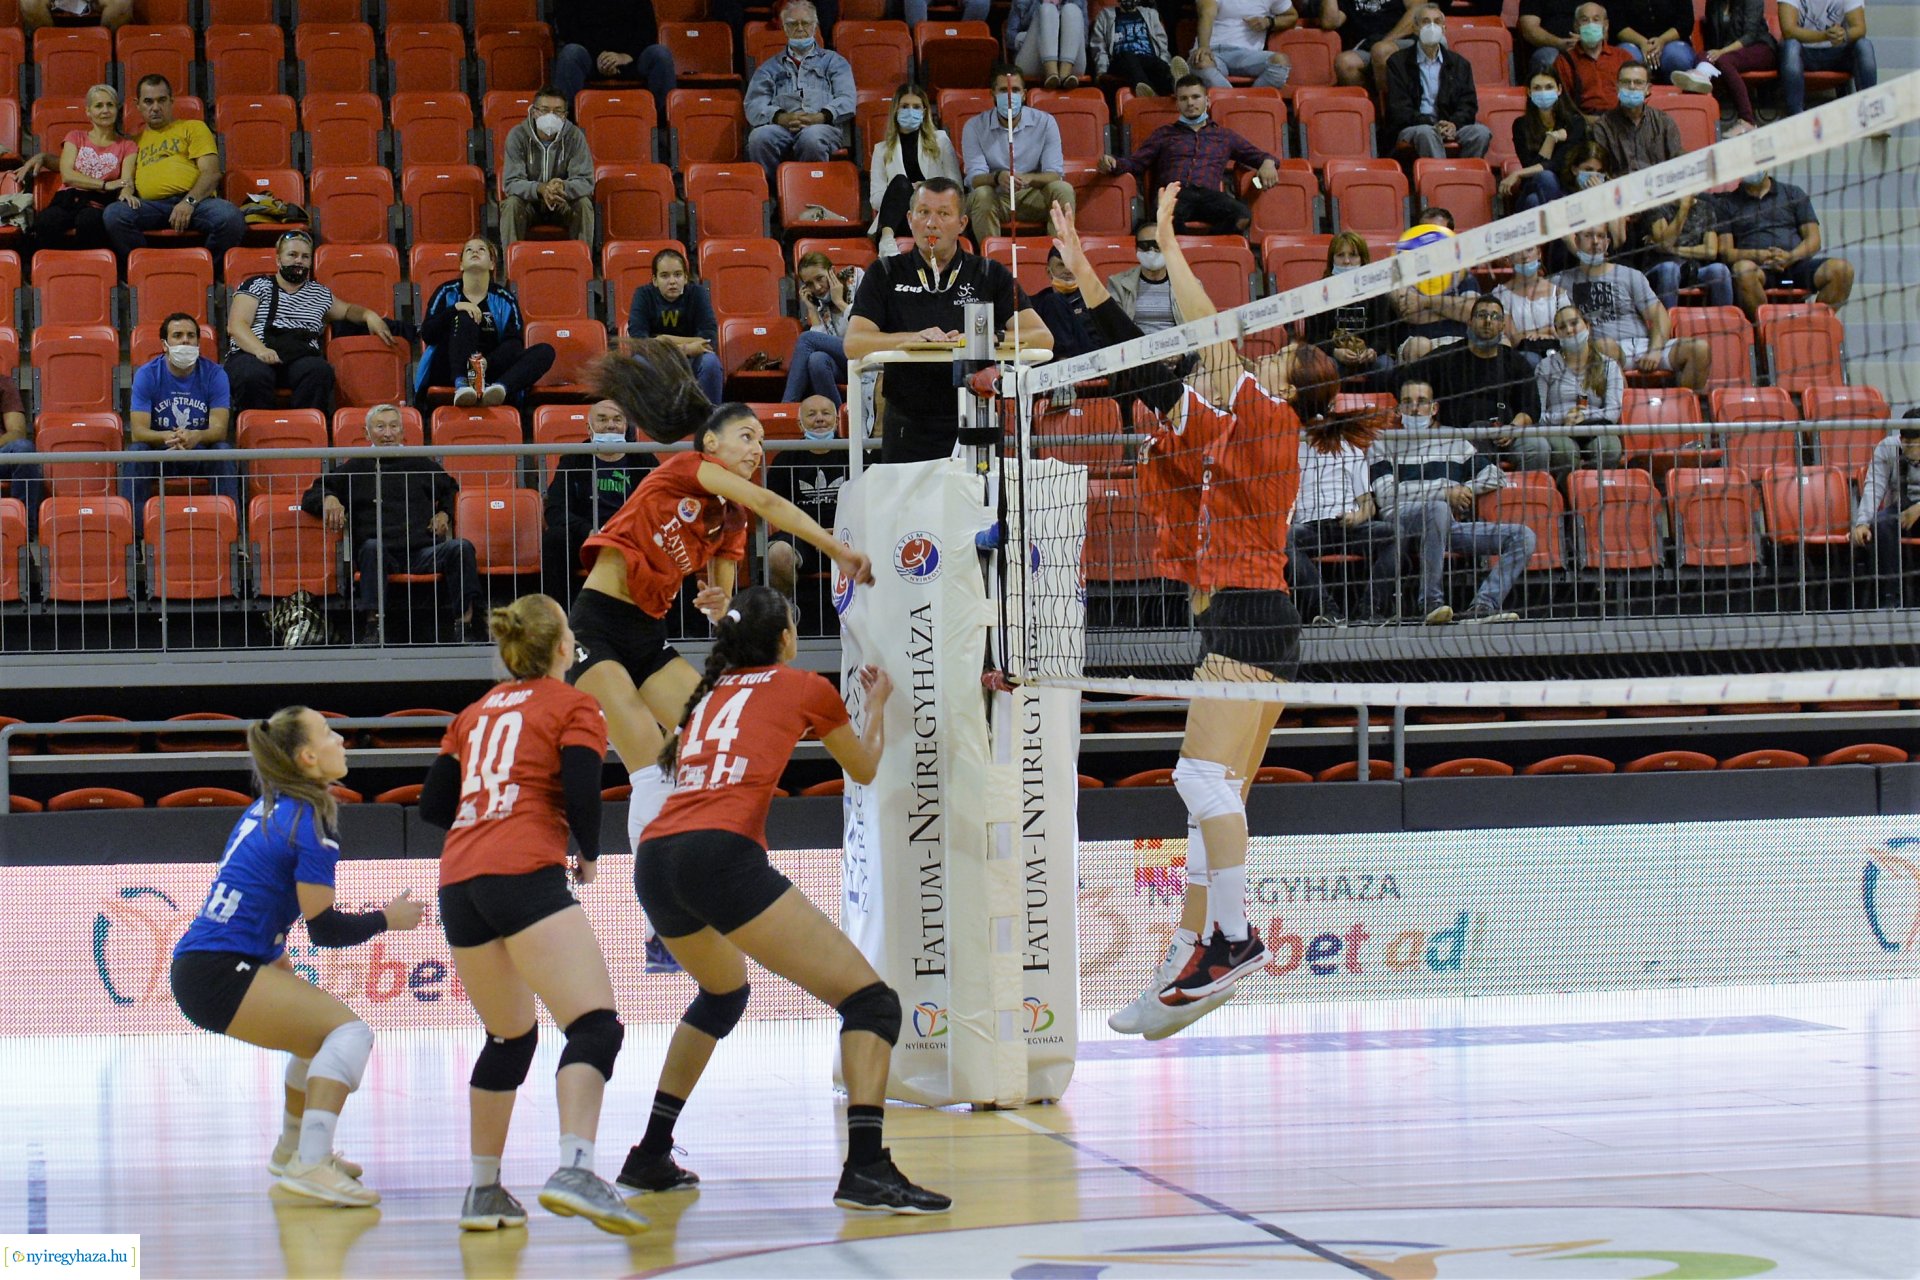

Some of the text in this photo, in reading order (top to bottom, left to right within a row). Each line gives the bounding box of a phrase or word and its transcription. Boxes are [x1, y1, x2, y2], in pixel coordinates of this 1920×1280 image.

[661, 310, 679, 328] W
[895, 533, 924, 559] FATUM
[681, 687, 754, 760] 14
[461, 710, 523, 800] 10
[1024, 1035, 1064, 1045] EGYHÁZA
